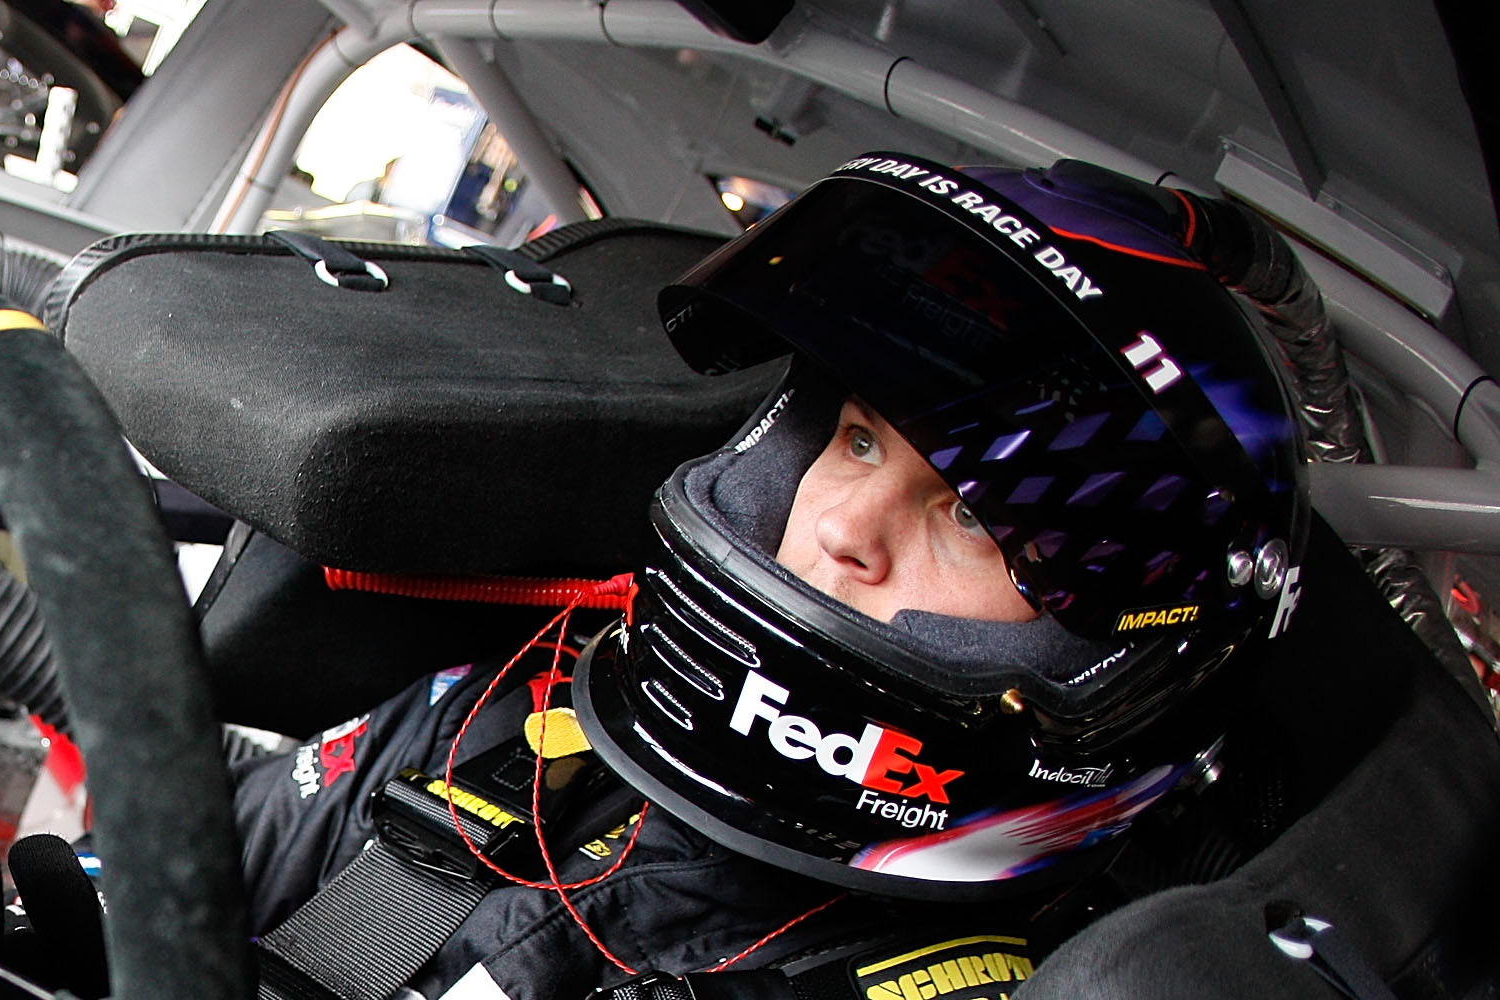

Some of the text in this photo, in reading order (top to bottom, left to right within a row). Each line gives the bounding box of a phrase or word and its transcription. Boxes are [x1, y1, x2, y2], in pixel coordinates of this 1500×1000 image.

[869, 160, 930, 180] DAY
[918, 175, 959, 195] IS
[951, 191, 1041, 250] RACE
[1034, 246, 1104, 301] DAY
[1120, 330, 1187, 394] 11
[1116, 605, 1199, 631] IMPACT!
[728, 669, 966, 804] FedEx
[855, 789, 949, 831] Freight
